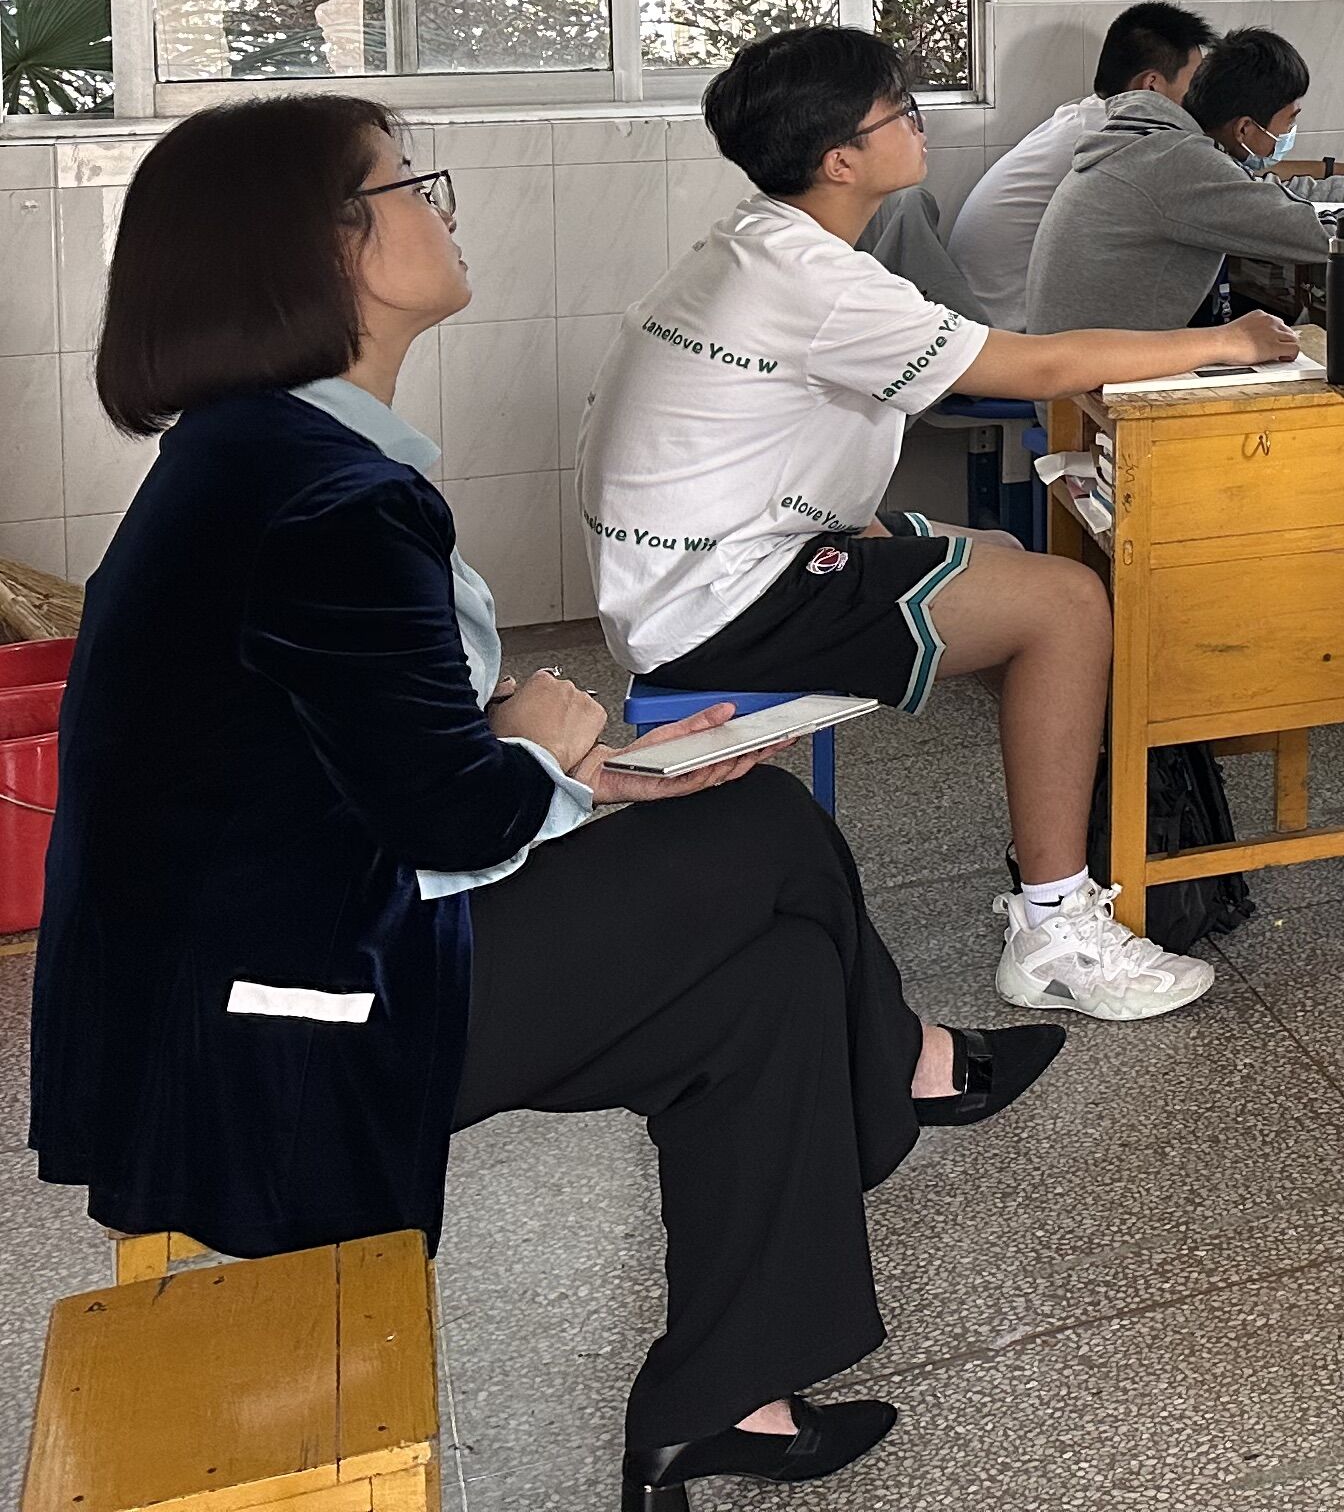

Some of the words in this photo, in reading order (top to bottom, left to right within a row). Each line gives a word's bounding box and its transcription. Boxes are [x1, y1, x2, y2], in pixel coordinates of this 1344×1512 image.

[710, 342, 750, 370] You
[872, 336, 948, 402] Lanelove
[781, 495, 823, 522] elove
[634, 528, 676, 550] You
